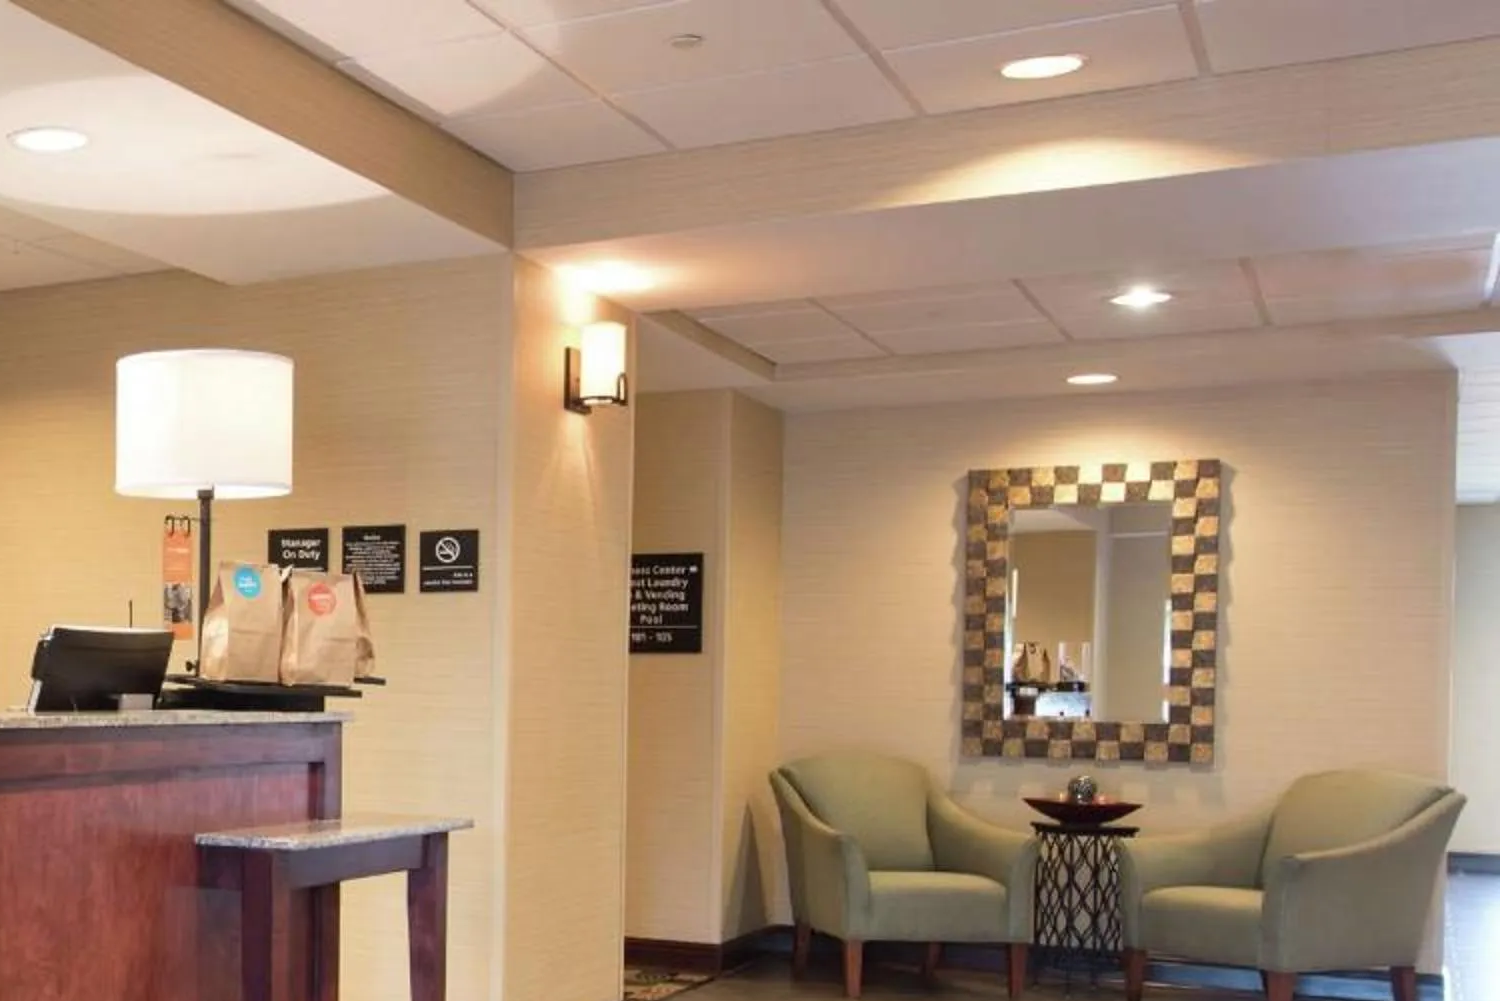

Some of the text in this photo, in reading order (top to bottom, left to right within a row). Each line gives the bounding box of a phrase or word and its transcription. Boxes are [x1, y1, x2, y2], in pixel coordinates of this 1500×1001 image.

[281, 539, 321, 549] Manager
[282, 550, 321, 560] On Duty
[652, 566, 686, 575] Center
[647, 578, 688, 589] Laundry
[644, 590, 685, 601] Vending
[659, 603, 689, 612] Room
[639, 614, 663, 624] Pool
